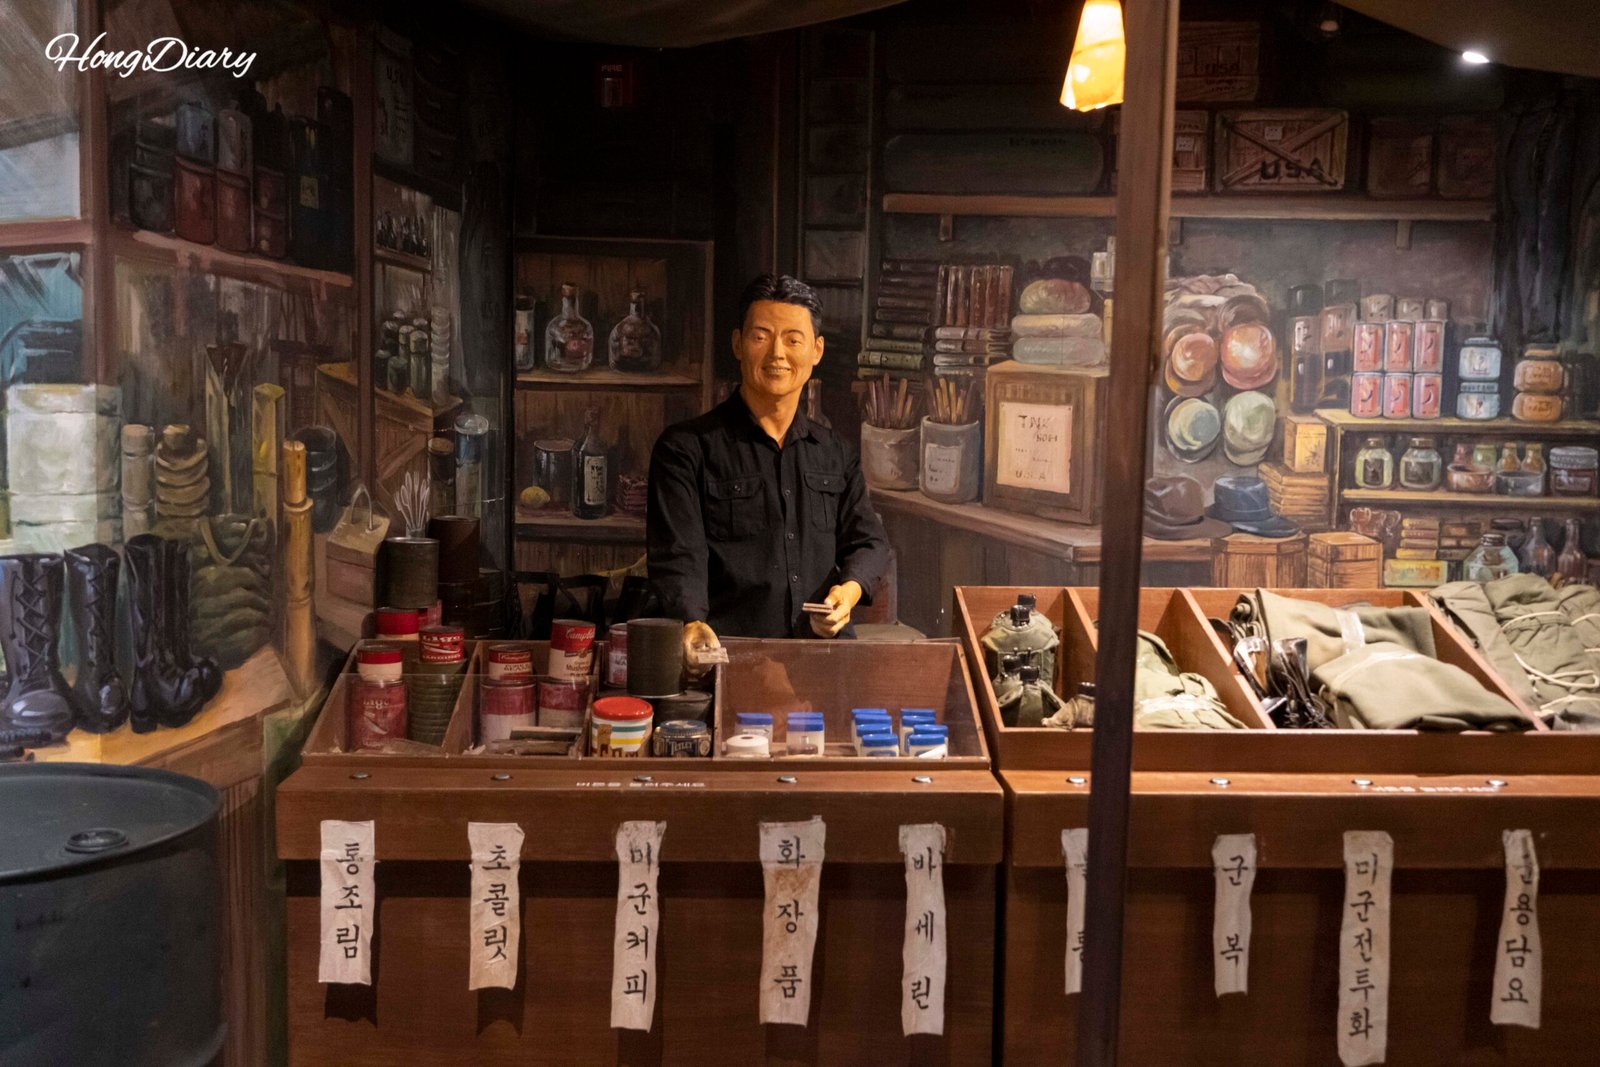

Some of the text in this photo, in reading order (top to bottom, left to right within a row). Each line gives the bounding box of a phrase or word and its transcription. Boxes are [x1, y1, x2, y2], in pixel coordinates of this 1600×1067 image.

[334, 842, 363, 959] 통조림
[481, 845, 511, 961] 초콜릿
[623, 841, 653, 1006] 미군커피
[774, 835, 806, 999] 화장품
[911, 846, 938, 1010] 바세린
[1221, 855, 1248, 966] 군복
[1349, 852, 1379, 1040] 미군전투화
